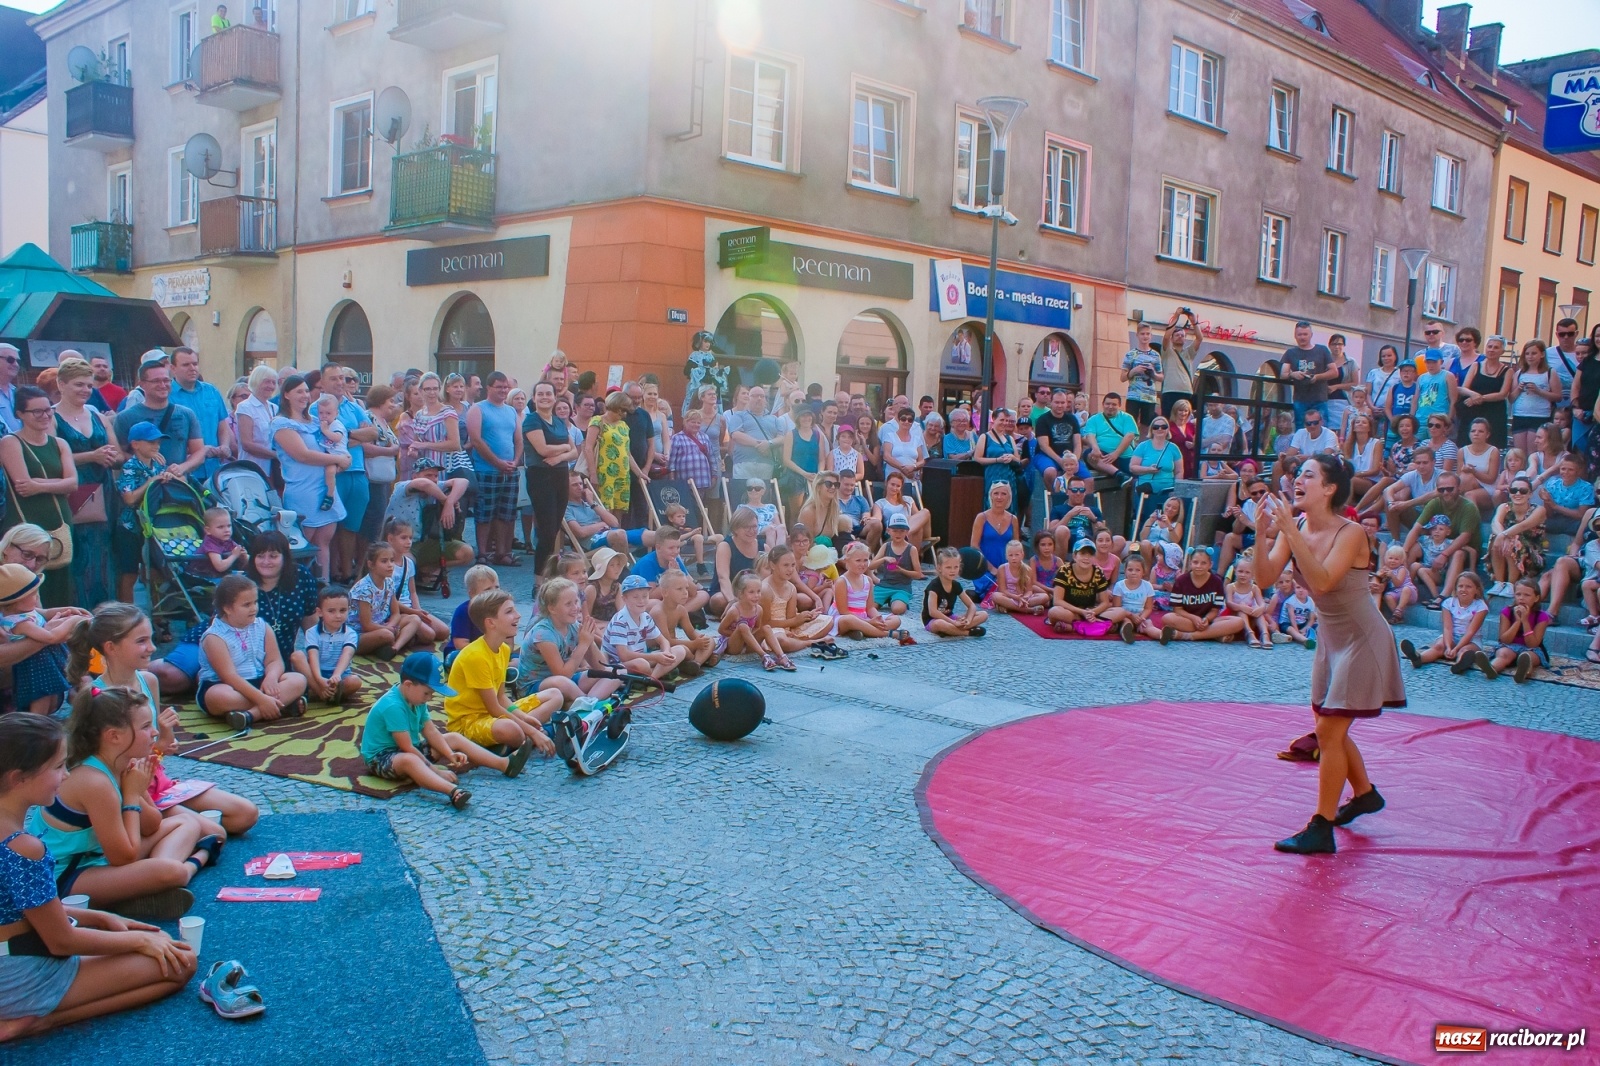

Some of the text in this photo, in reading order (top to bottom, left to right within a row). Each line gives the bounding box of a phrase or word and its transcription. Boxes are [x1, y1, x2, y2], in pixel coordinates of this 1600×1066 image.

[967, 281, 1004, 300] Bodra
[1011, 291, 1043, 307] męska
[1045, 297, 1069, 310] rzecz
